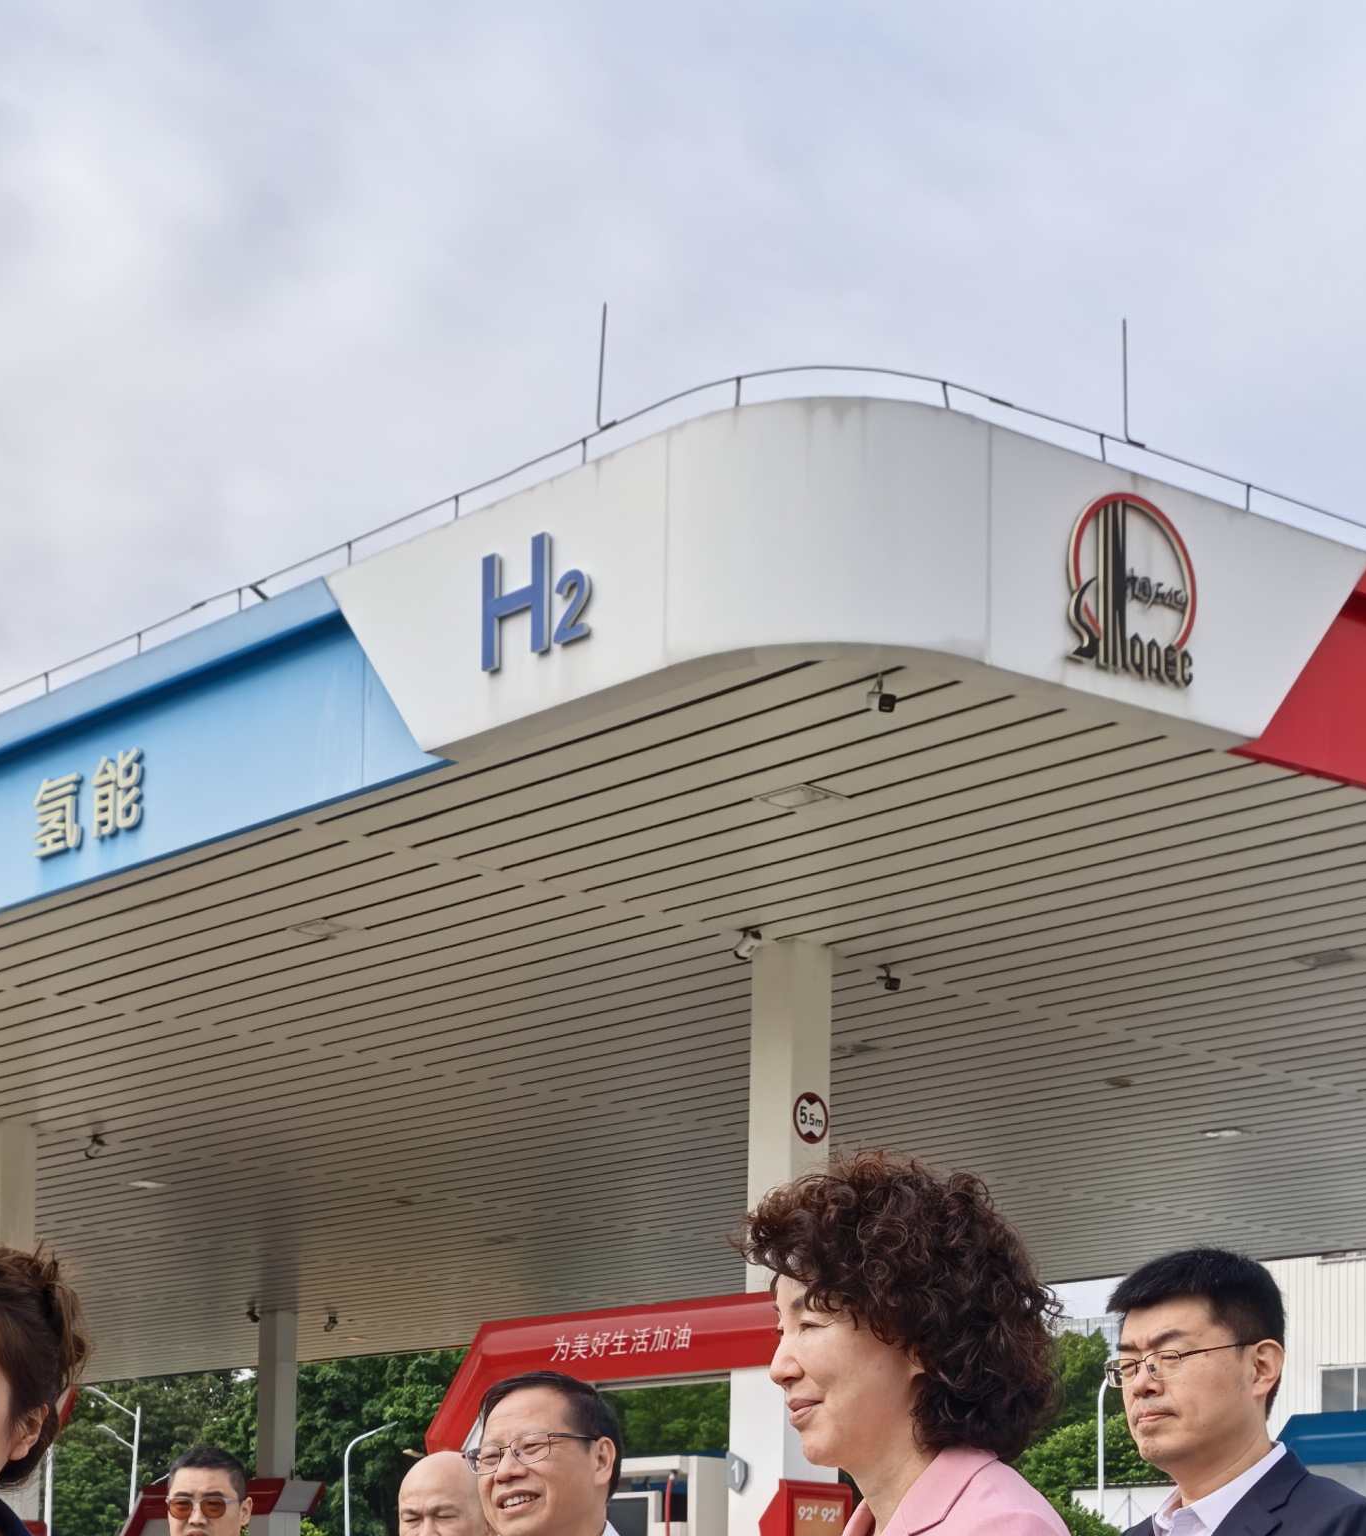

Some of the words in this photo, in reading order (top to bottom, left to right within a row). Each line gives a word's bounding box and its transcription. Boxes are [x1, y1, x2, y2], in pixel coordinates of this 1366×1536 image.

[481, 531, 593, 673] H2
[32, 745, 145, 859] 氢能
[799, 1105, 824, 1128] 5.5m
[549, 1322, 693, 1362] 为美好生活加油
[731, 1460, 740, 1484] 1
